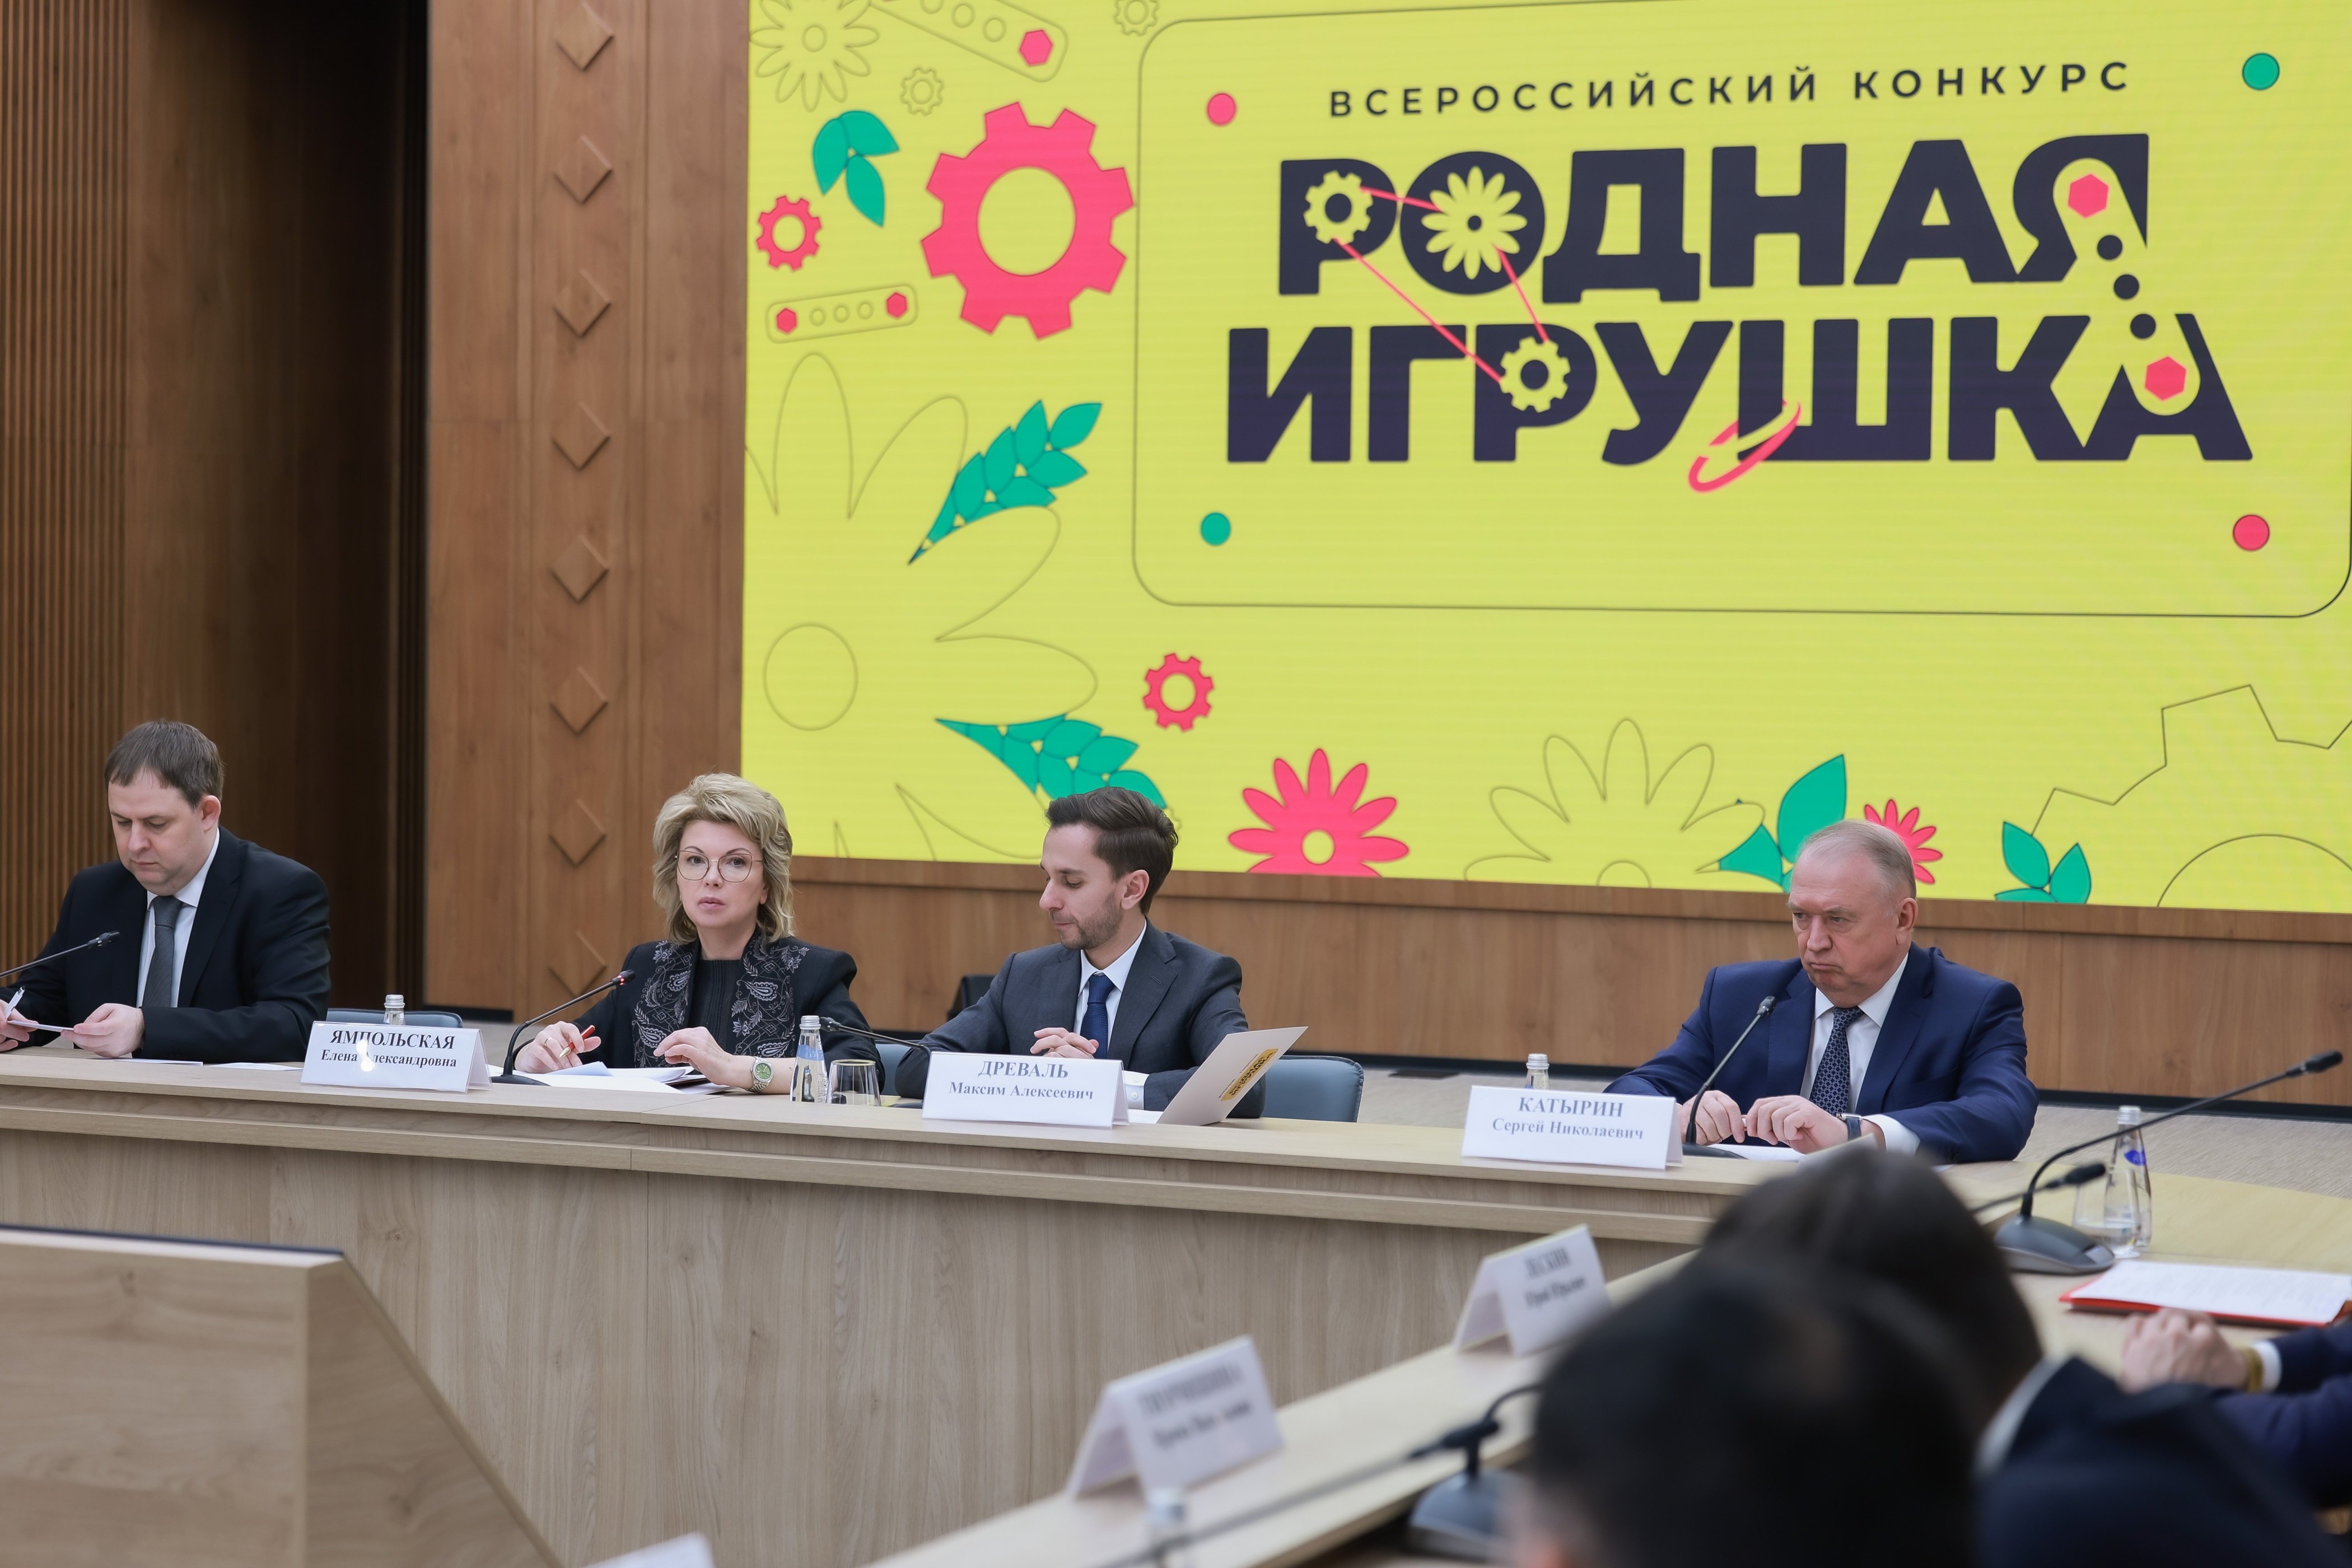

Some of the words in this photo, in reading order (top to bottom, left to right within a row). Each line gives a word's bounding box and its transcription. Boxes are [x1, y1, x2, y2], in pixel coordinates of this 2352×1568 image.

[1331, 66, 1815, 118] ВСЕРОССИЙСКИЙ
[1854, 61, 2127, 99] КОНКУРС
[1278, 133, 2149, 304] РОДНАЯ
[1228, 312, 2253, 465] ИГРУШКА
[329, 1030, 456, 1049] ЯМПОЛЬСКАЯ
[321, 1049, 357, 1062] Елена
[363, 1051, 457, 1068] лександровна
[978, 1061, 1068, 1079] ДРЕВАЛЬ
[949, 1081, 1006, 1096] Максим
[1010, 1083, 1094, 1100] Алексеевич
[1519, 1097, 1625, 1118] КАТЫРИН
[1492, 1118, 1544, 1135] Сергей
[1550, 1121, 1644, 1140] Николаевич
